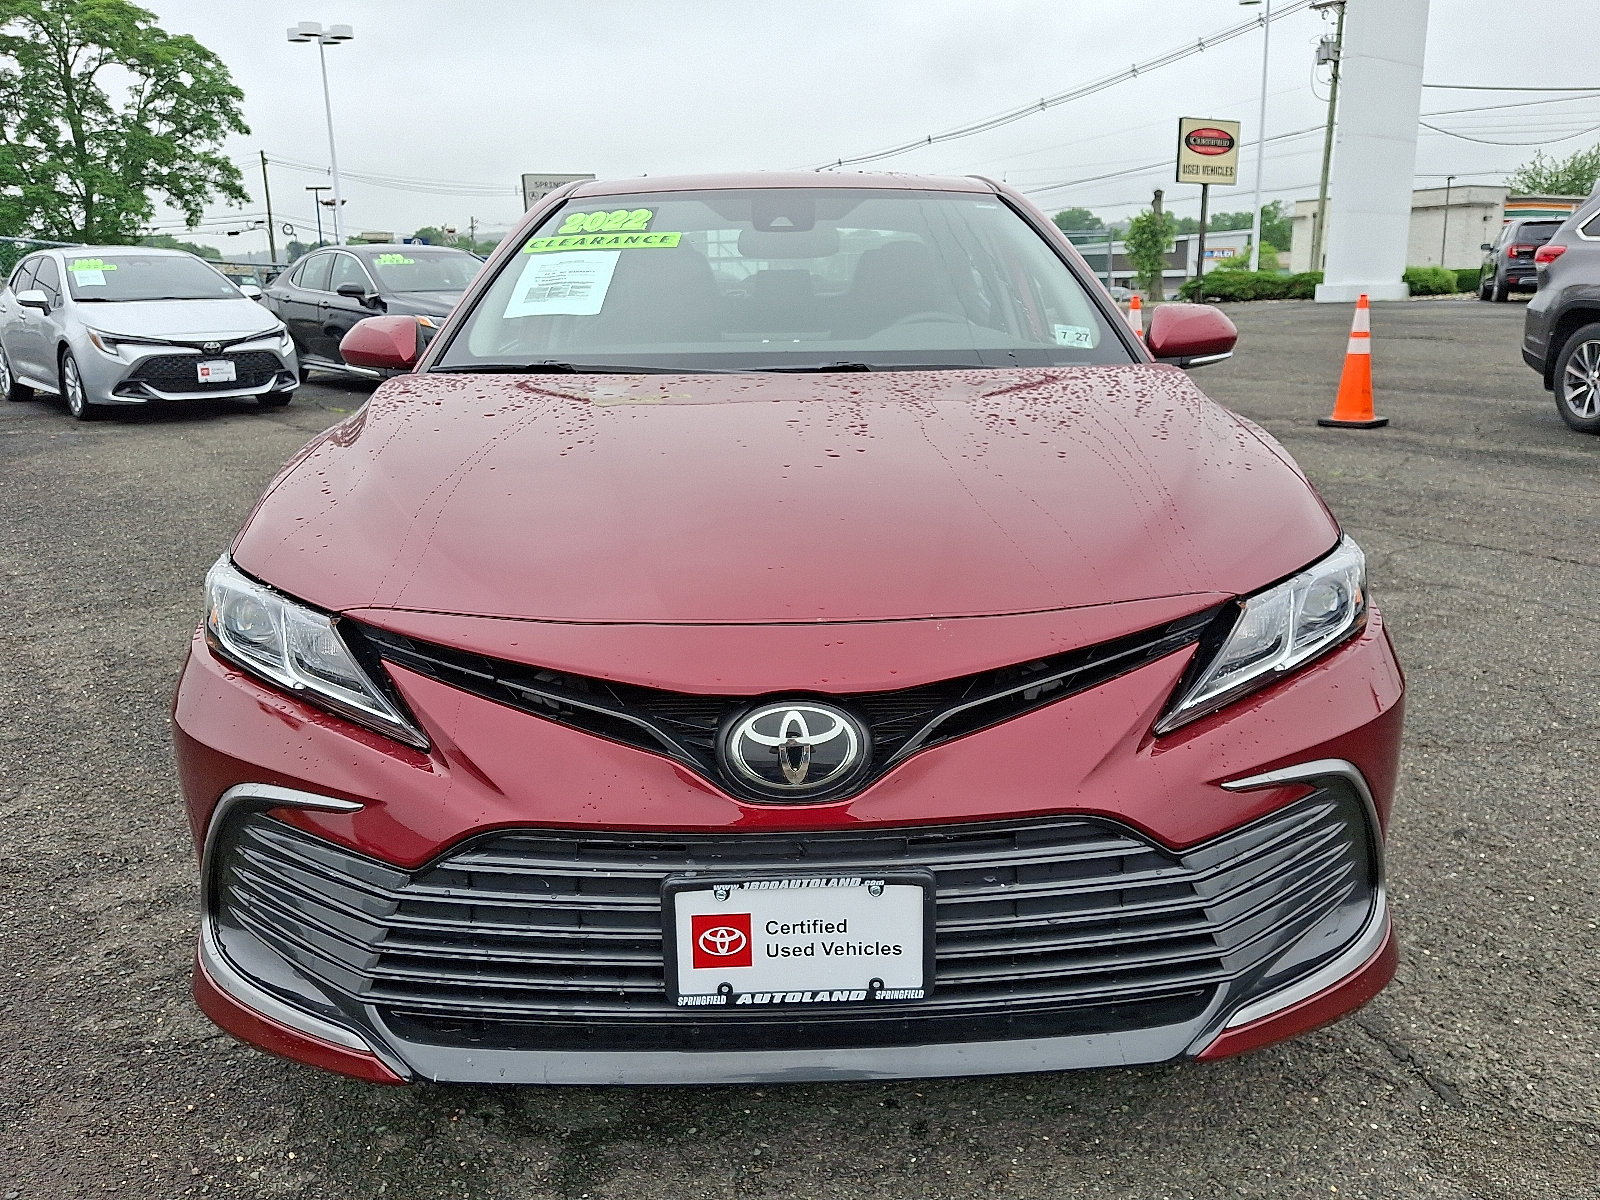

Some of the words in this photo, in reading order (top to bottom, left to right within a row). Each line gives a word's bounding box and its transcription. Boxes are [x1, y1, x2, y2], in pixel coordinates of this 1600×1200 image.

[1183, 164, 1200, 175] USED
[1202, 165, 1234, 177] VEHICLES
[557, 208, 653, 234] 2022
[529, 235, 670, 249] CLEARANCE
[1061, 331, 1067, 340] 7
[1075, 332, 1089, 342] 27
[765, 919, 848, 935] Certified
[766, 942, 815, 958] Used
[821, 941, 903, 956] Vehicles
[677, 995, 727, 1006] SPRINGFIELD
[735, 990, 867, 1005] AUTOLAND
[875, 989, 925, 1000] SPRINGFIELD
